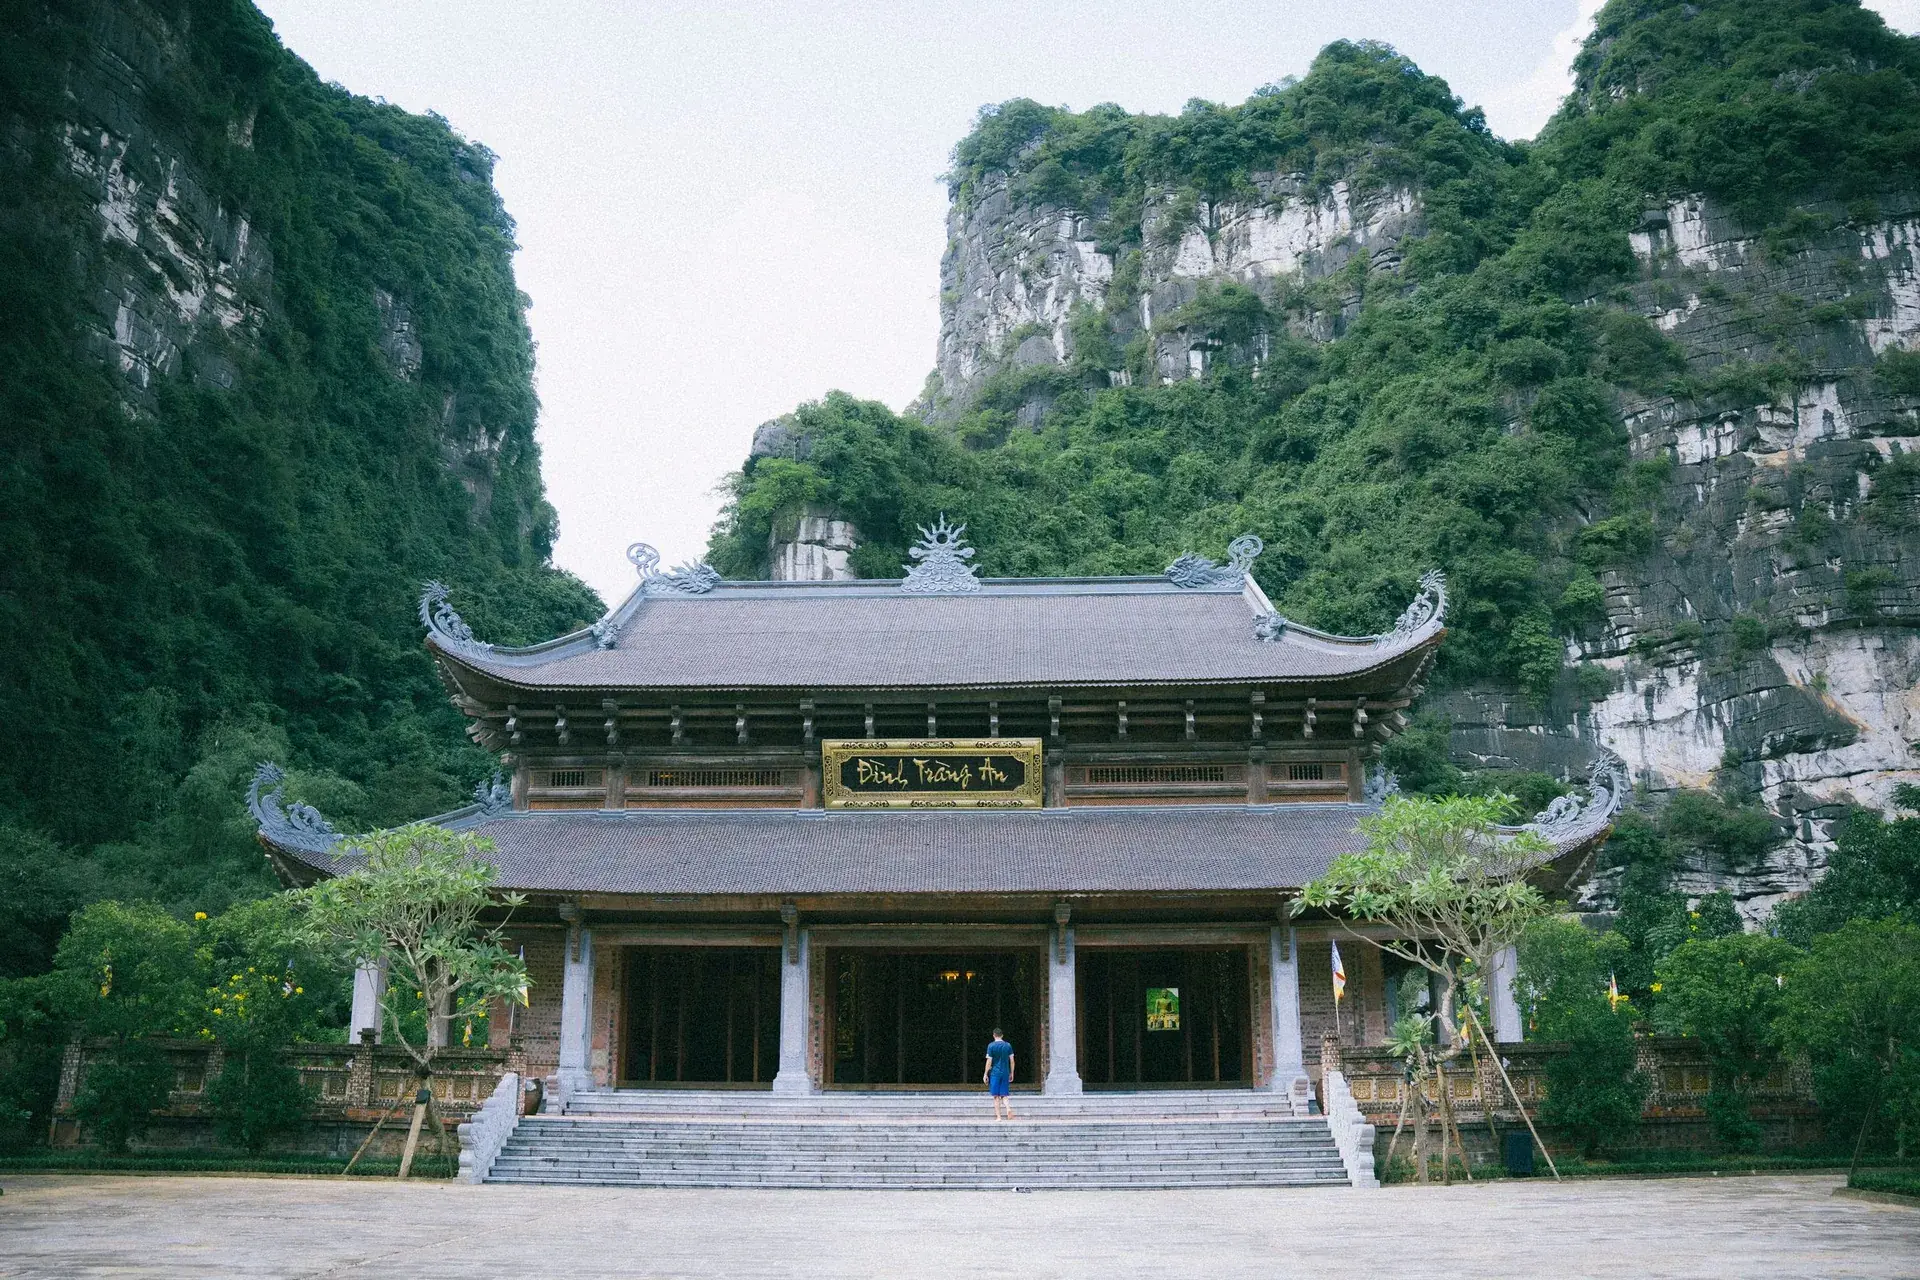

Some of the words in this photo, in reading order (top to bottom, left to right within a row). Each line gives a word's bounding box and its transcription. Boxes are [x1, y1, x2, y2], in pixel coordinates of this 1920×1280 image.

[857, 758, 908, 789] Đình
[913, 758, 973, 790] Tràng
[978, 757, 1009, 787] An
